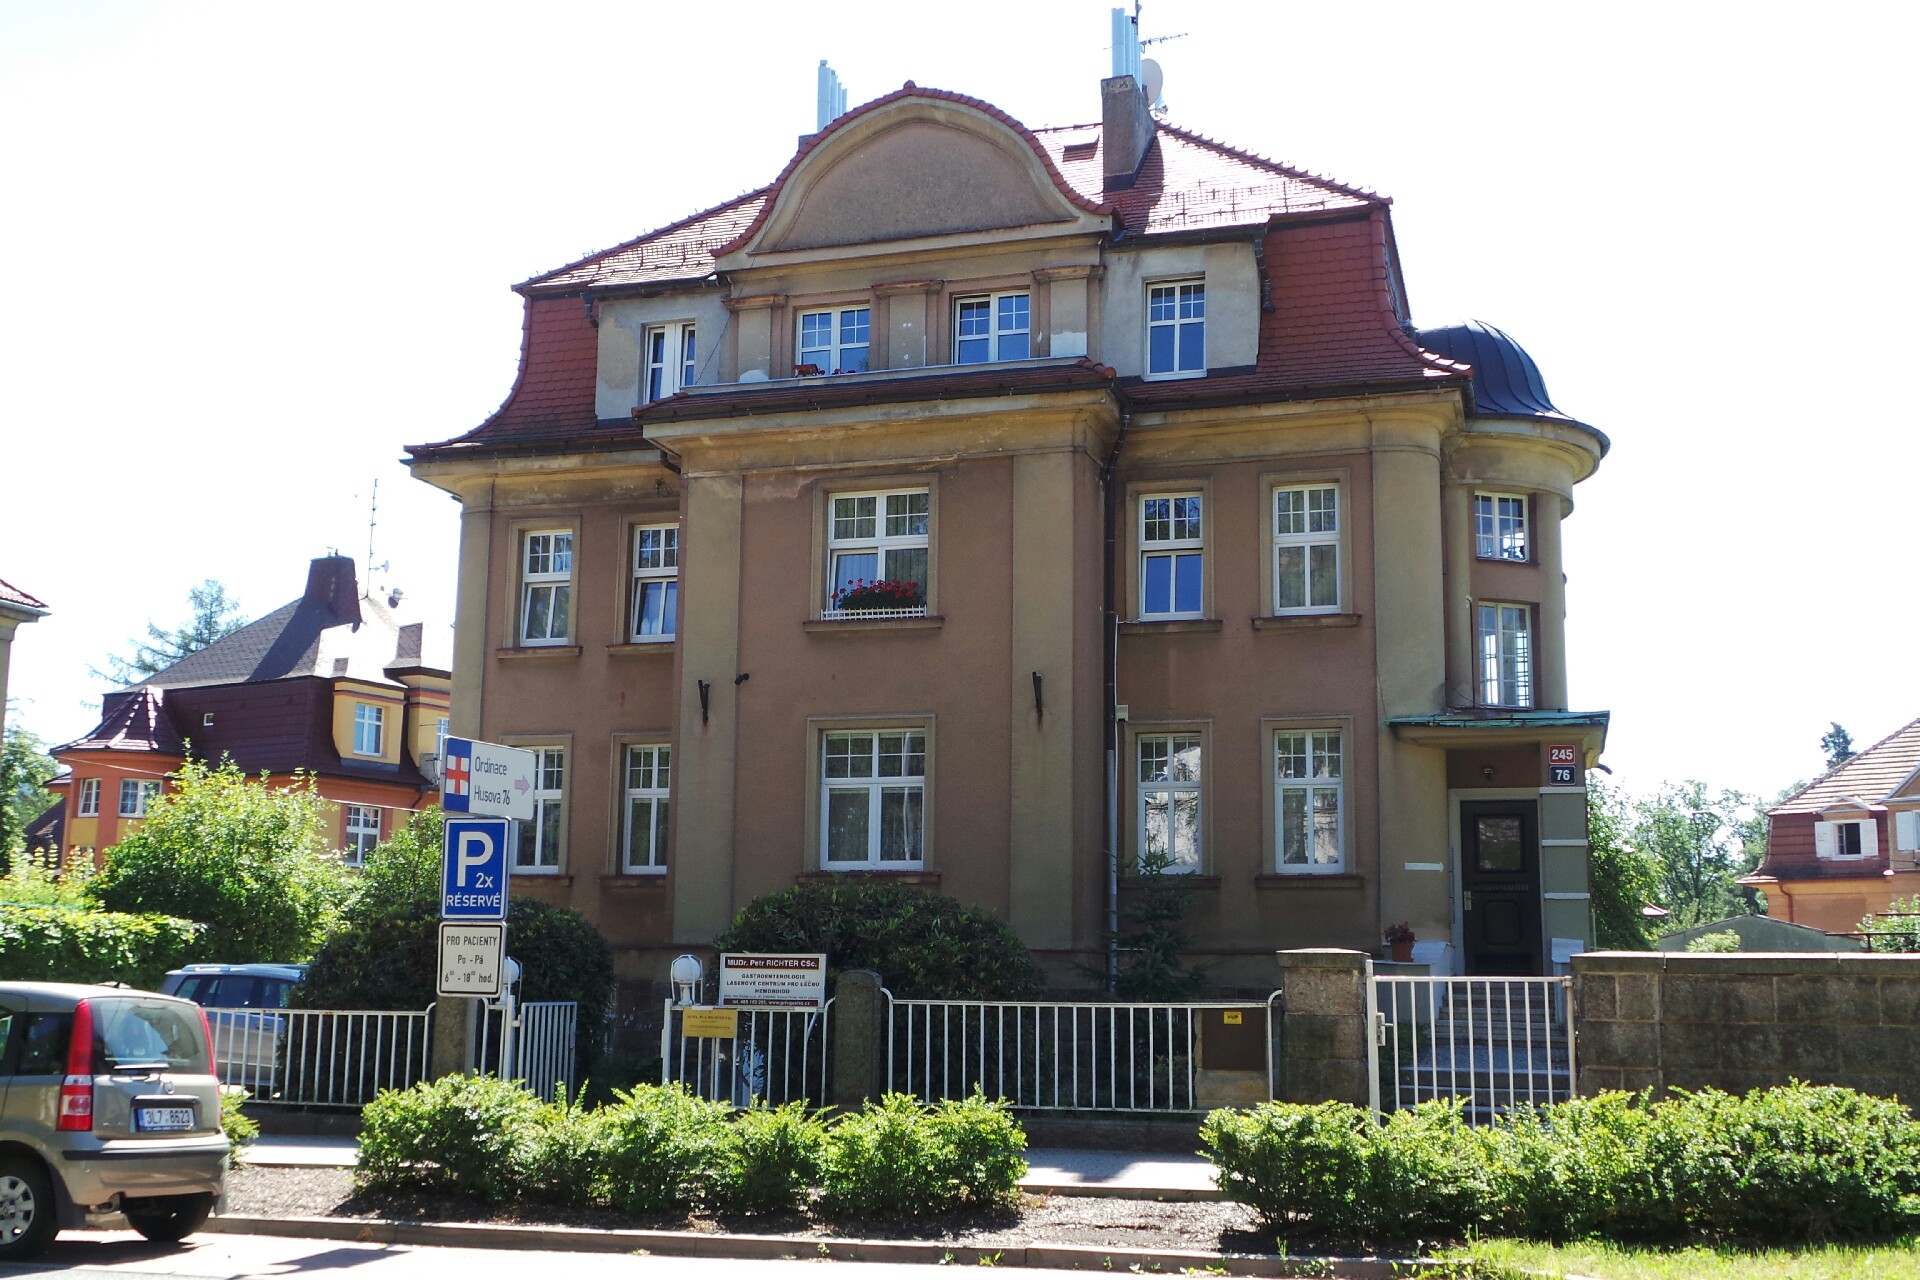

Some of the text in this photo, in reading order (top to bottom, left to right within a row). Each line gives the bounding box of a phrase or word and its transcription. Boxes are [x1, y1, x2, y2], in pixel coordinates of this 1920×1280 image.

[1551, 749, 1573, 760] 245
[474, 756, 508, 776] Ordinace
[1555, 769, 1571, 781] 76
[474, 785, 511, 806] Husova 76
[456, 831, 494, 887] P
[475, 872, 493, 889] 2x
[445, 892, 501, 908] RÉSERVÉ
[446, 935, 498, 947] PRO PACIENTY
[457, 954, 467, 965] Po
[750, 959, 765, 967] Petr
[766, 959, 799, 967] RICHTER
[800, 960, 818, 968] CSc.
[478, 972, 494, 984] hod.
